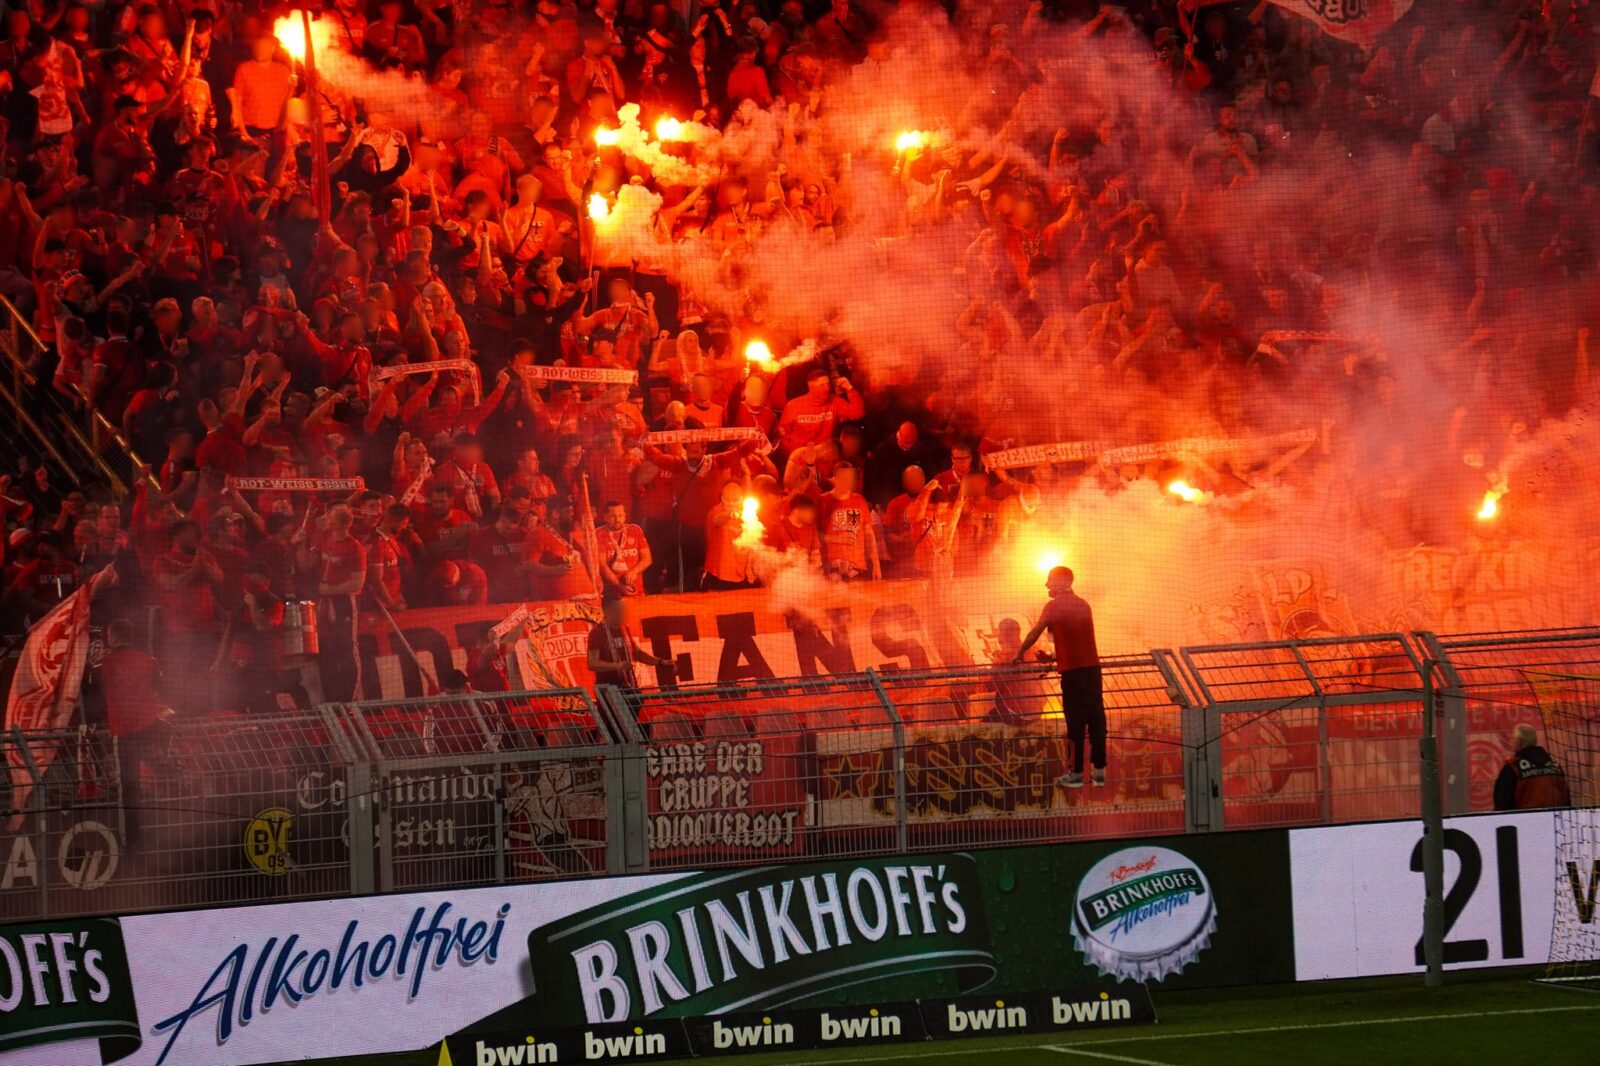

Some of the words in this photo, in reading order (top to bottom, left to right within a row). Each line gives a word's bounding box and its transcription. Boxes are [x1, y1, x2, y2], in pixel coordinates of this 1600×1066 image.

[547, 637, 581, 657] RUDE
[641, 603, 934, 701] FANS
[659, 775, 751, 812] GRUPPE
[716, 741, 764, 775] DER
[571, 866, 967, 1025] BRINKHOFF's
[153, 901, 511, 1066] Alkoholfrei
[476, 1035, 557, 1066] bwin
[584, 1026, 666, 1059] bwin
[713, 1016, 794, 1049] bwin
[820, 1008, 901, 1041] bwin
[948, 1000, 1027, 1032] bwin
[1052, 992, 1131, 1024] bwin
